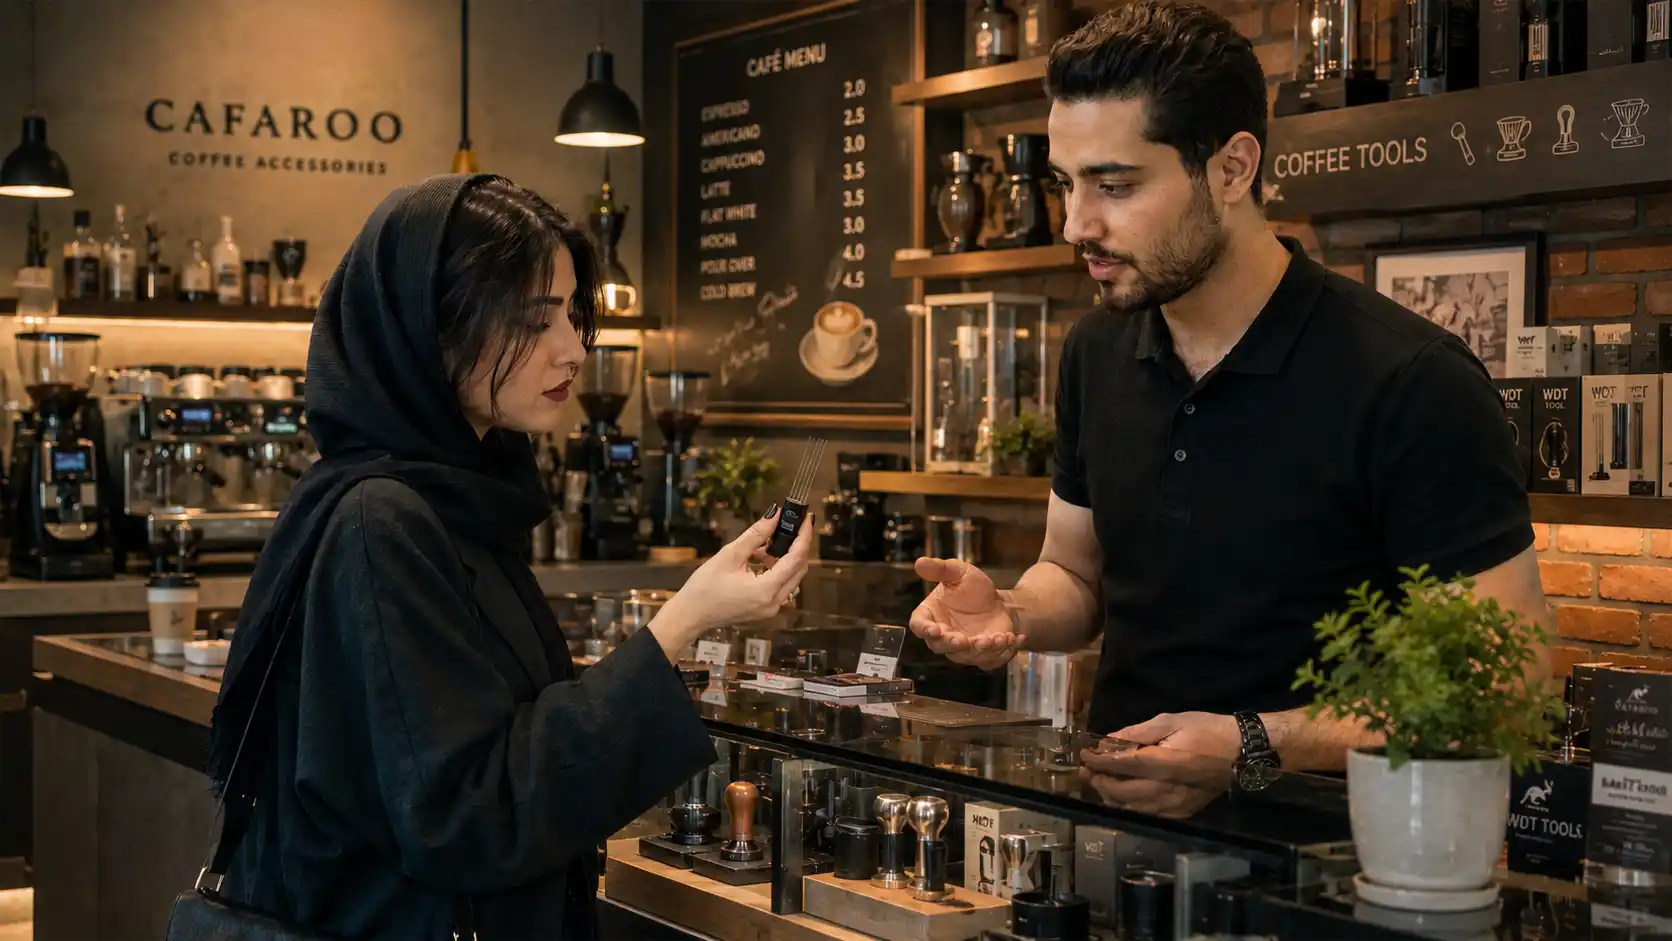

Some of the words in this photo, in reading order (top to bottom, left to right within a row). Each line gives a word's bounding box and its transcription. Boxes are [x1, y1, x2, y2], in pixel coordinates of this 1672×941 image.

[746, 48, 782, 77] CAFÉ
[784, 43, 826, 71] MENU
[843, 78, 866, 99] 2.0
[145, 98, 403, 144] CAFAROO
[843, 106, 865, 127] 2.5
[843, 134, 866, 153] 3.0
[168, 151, 245, 169] COFFEE
[255, 155, 387, 176] ACCESSORIES
[1274, 146, 1350, 178] COFFEE
[1356, 136, 1427, 169] TOOLS
[843, 161, 865, 181] 3.5
[843, 188, 865, 208] 3.5
[843, 215, 865, 235] 3.0
[843, 243, 865, 262] 4.0
[843, 270, 865, 289] 4.5
